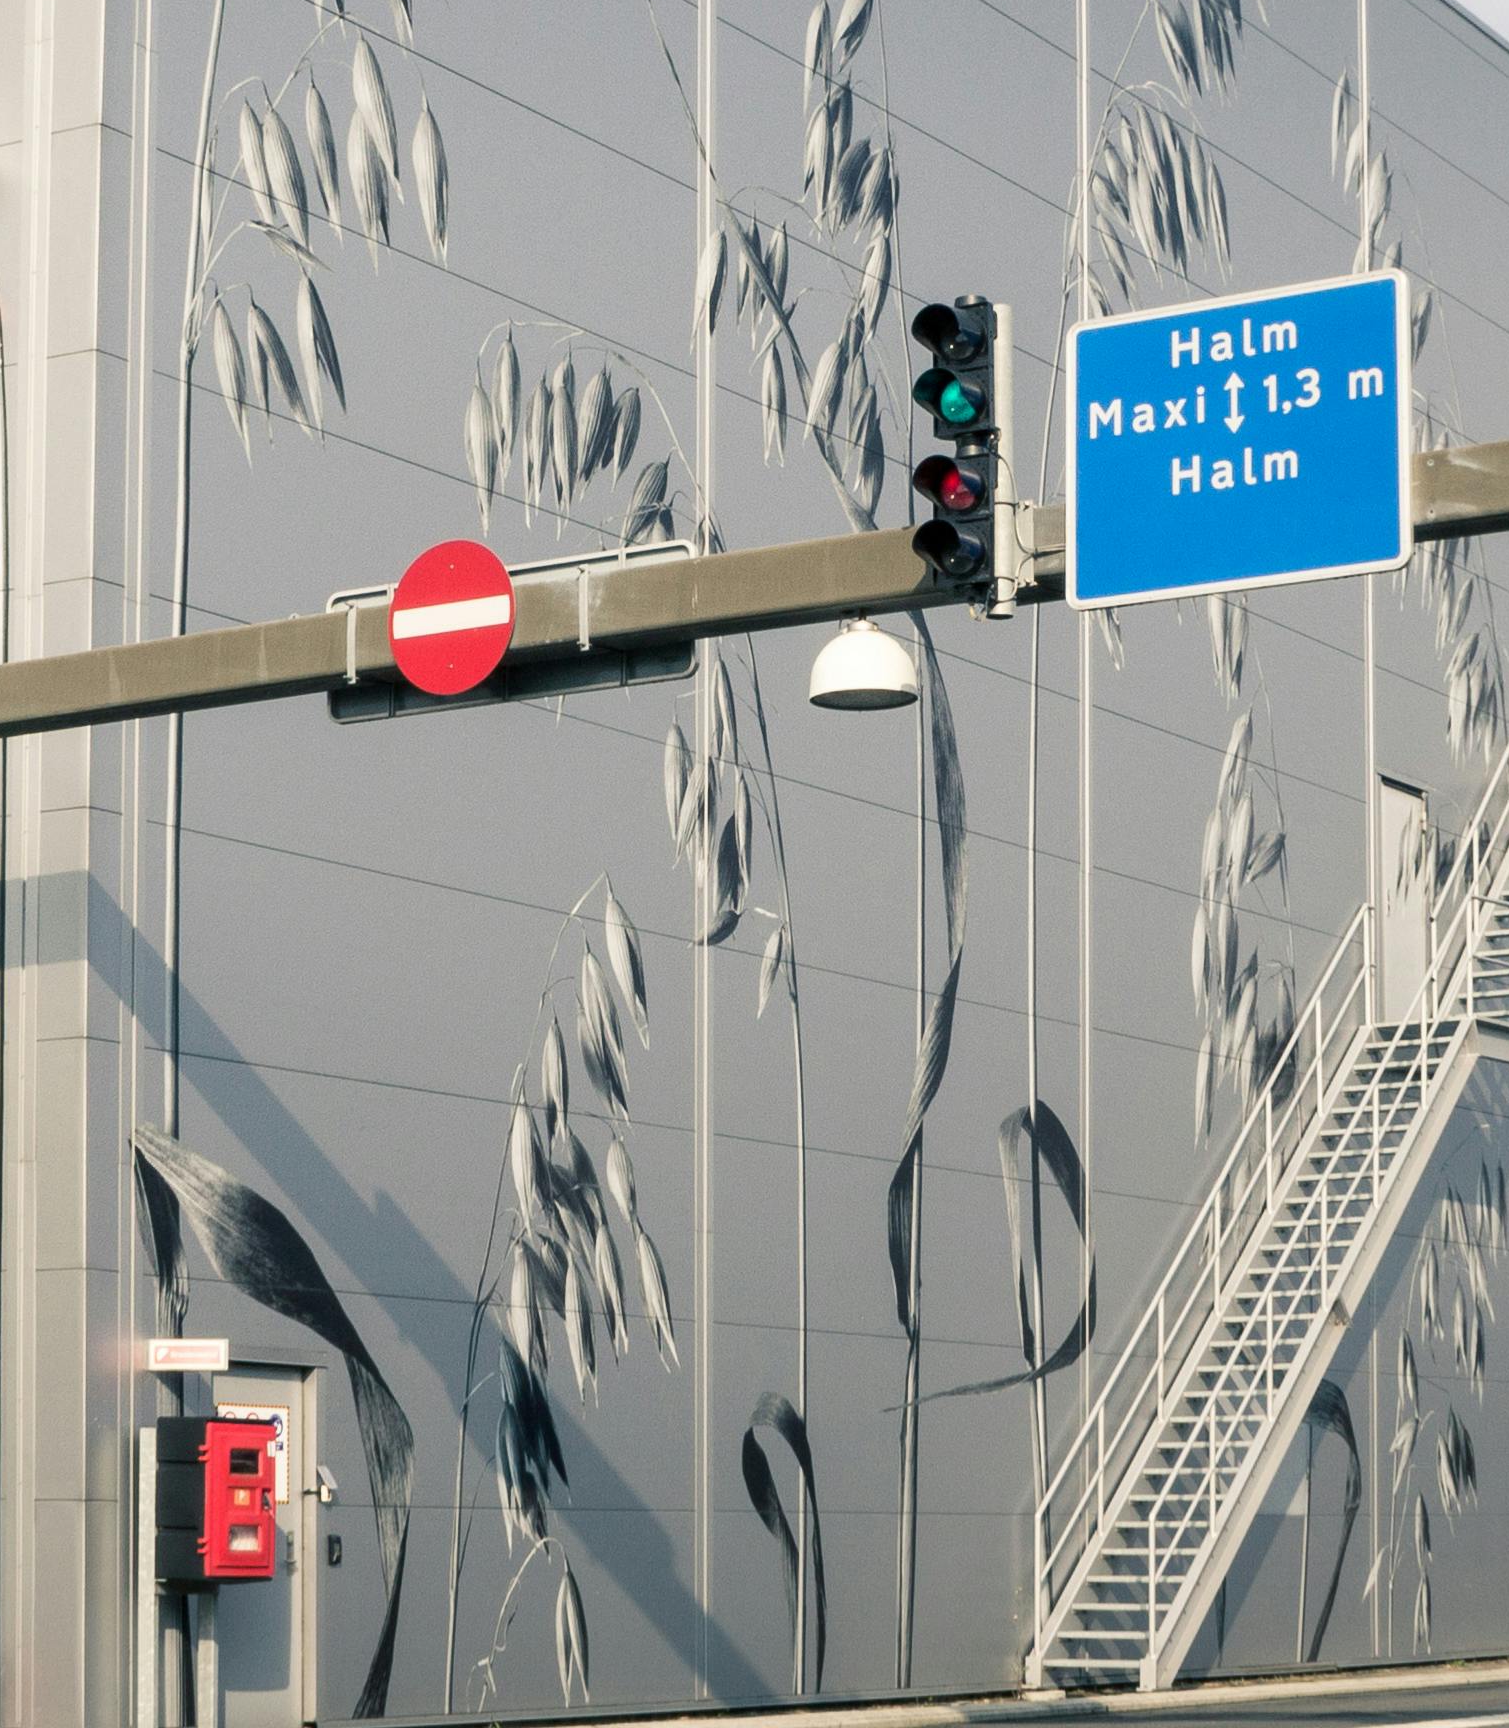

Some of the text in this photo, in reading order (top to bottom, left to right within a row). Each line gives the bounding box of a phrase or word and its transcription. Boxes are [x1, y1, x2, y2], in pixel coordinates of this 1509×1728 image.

[1170, 319, 1298, 369] Halm
[1089, 366, 1384, 440] Maxi 1,3 m
[1171, 446, 1299, 496] Halm
